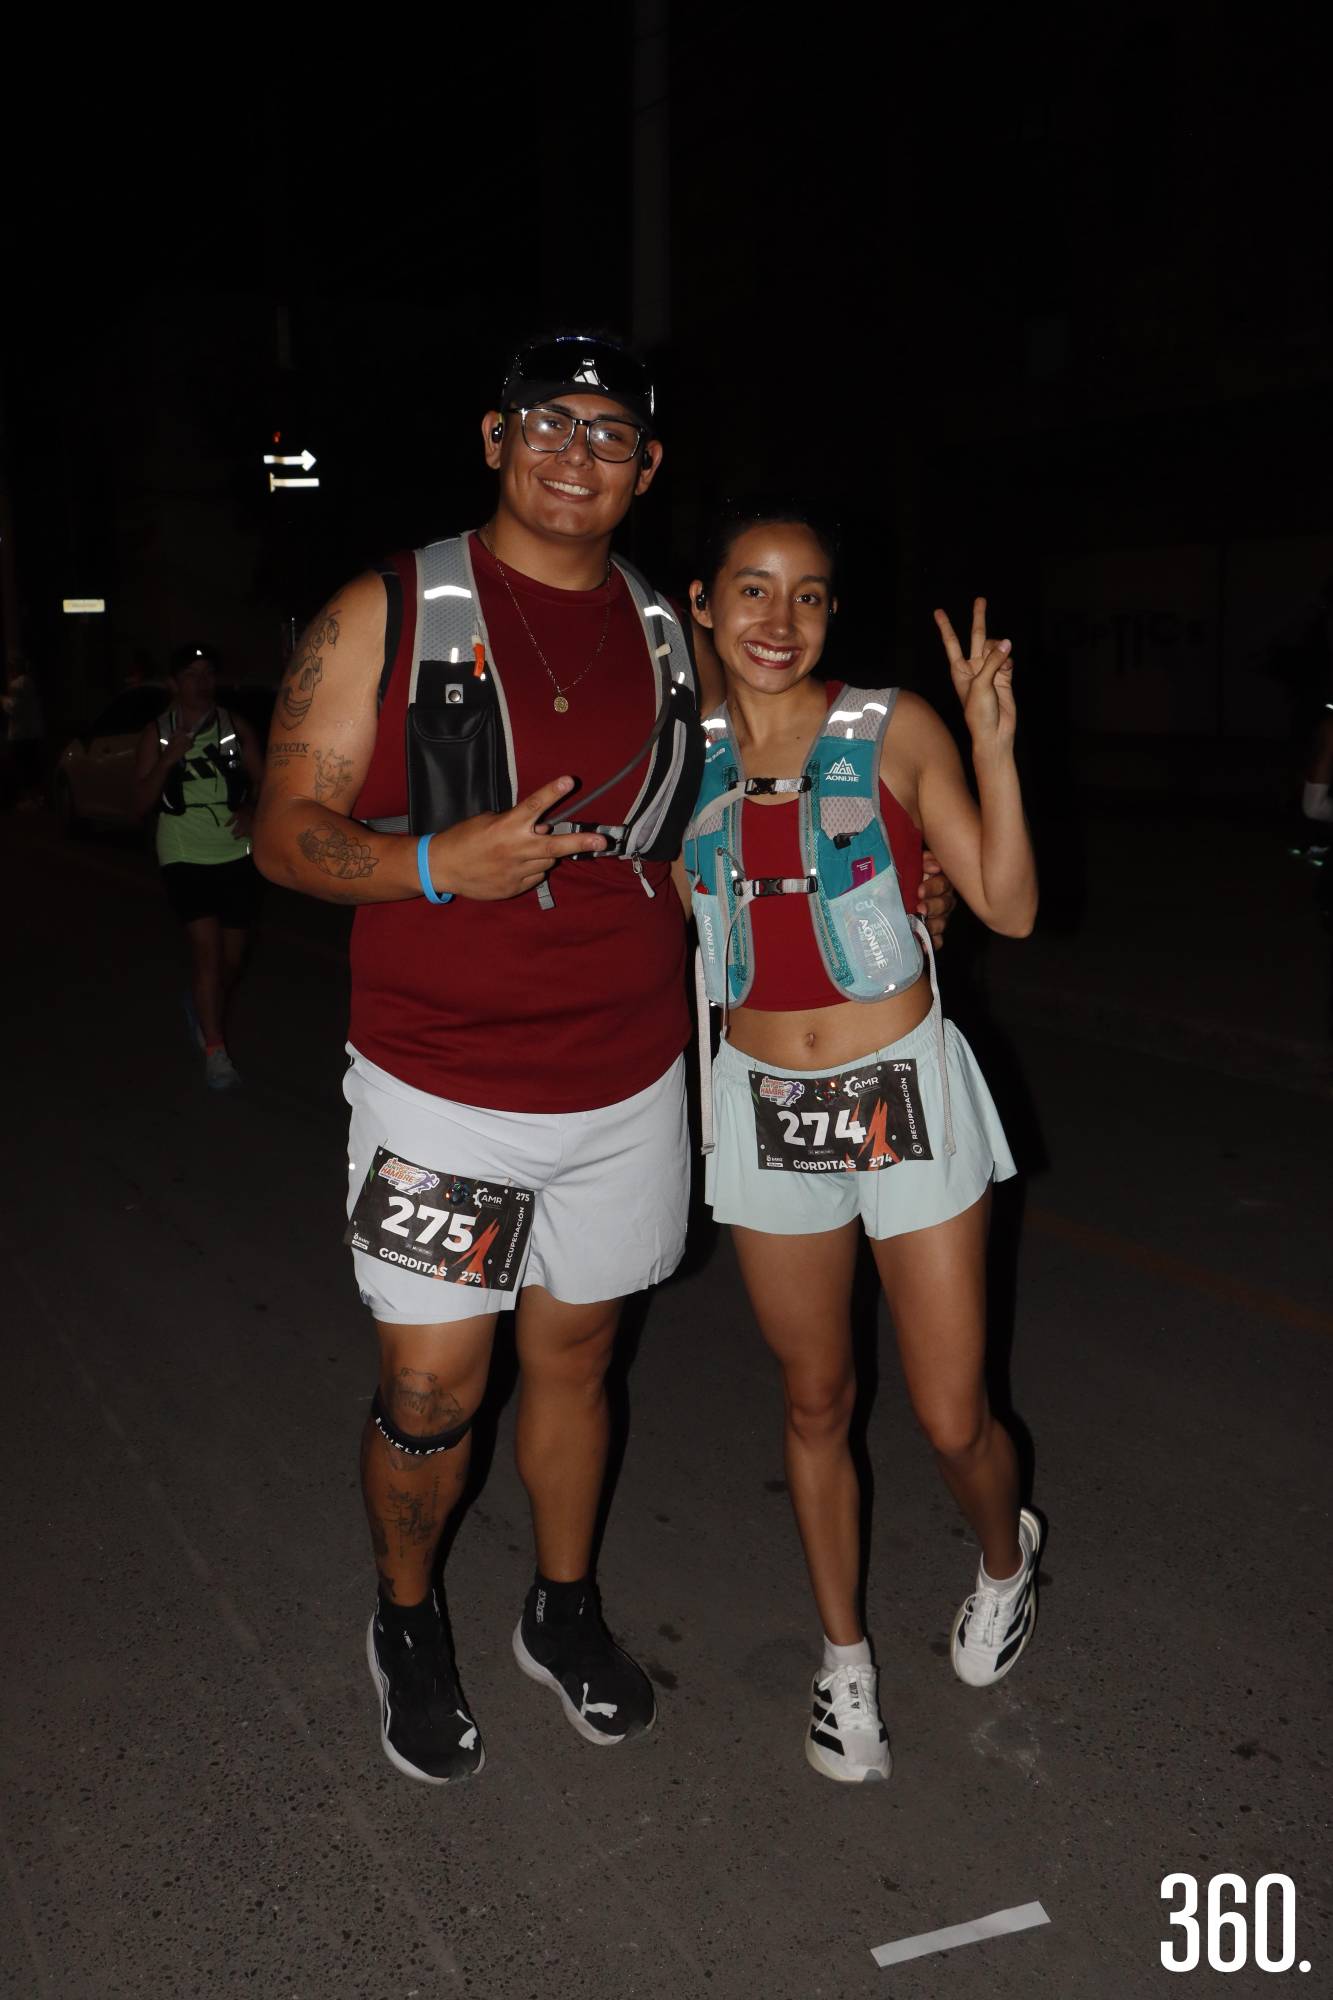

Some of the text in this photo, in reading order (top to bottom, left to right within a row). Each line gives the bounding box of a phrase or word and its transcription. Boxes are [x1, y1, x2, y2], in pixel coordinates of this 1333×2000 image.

[825, 774, 859, 783] AONIJIE
[892, 1062, 912, 1072] 274
[854, 1076, 880, 1091] AMR
[900, 1077, 918, 1140] RECUPERACIÓN
[777, 1110, 867, 1146] 274
[793, 1159, 857, 1172] GORDITAS
[868, 1153, 893, 1169] 274
[481, 1194, 503, 1205] AMR
[515, 1191, 531, 1202] 275
[380, 1195, 477, 1253] 275
[504, 1206, 525, 1269] RECUPERACIÓN
[378, 1247, 449, 1277] GORDITAS
[459, 1271, 482, 1284] 275
